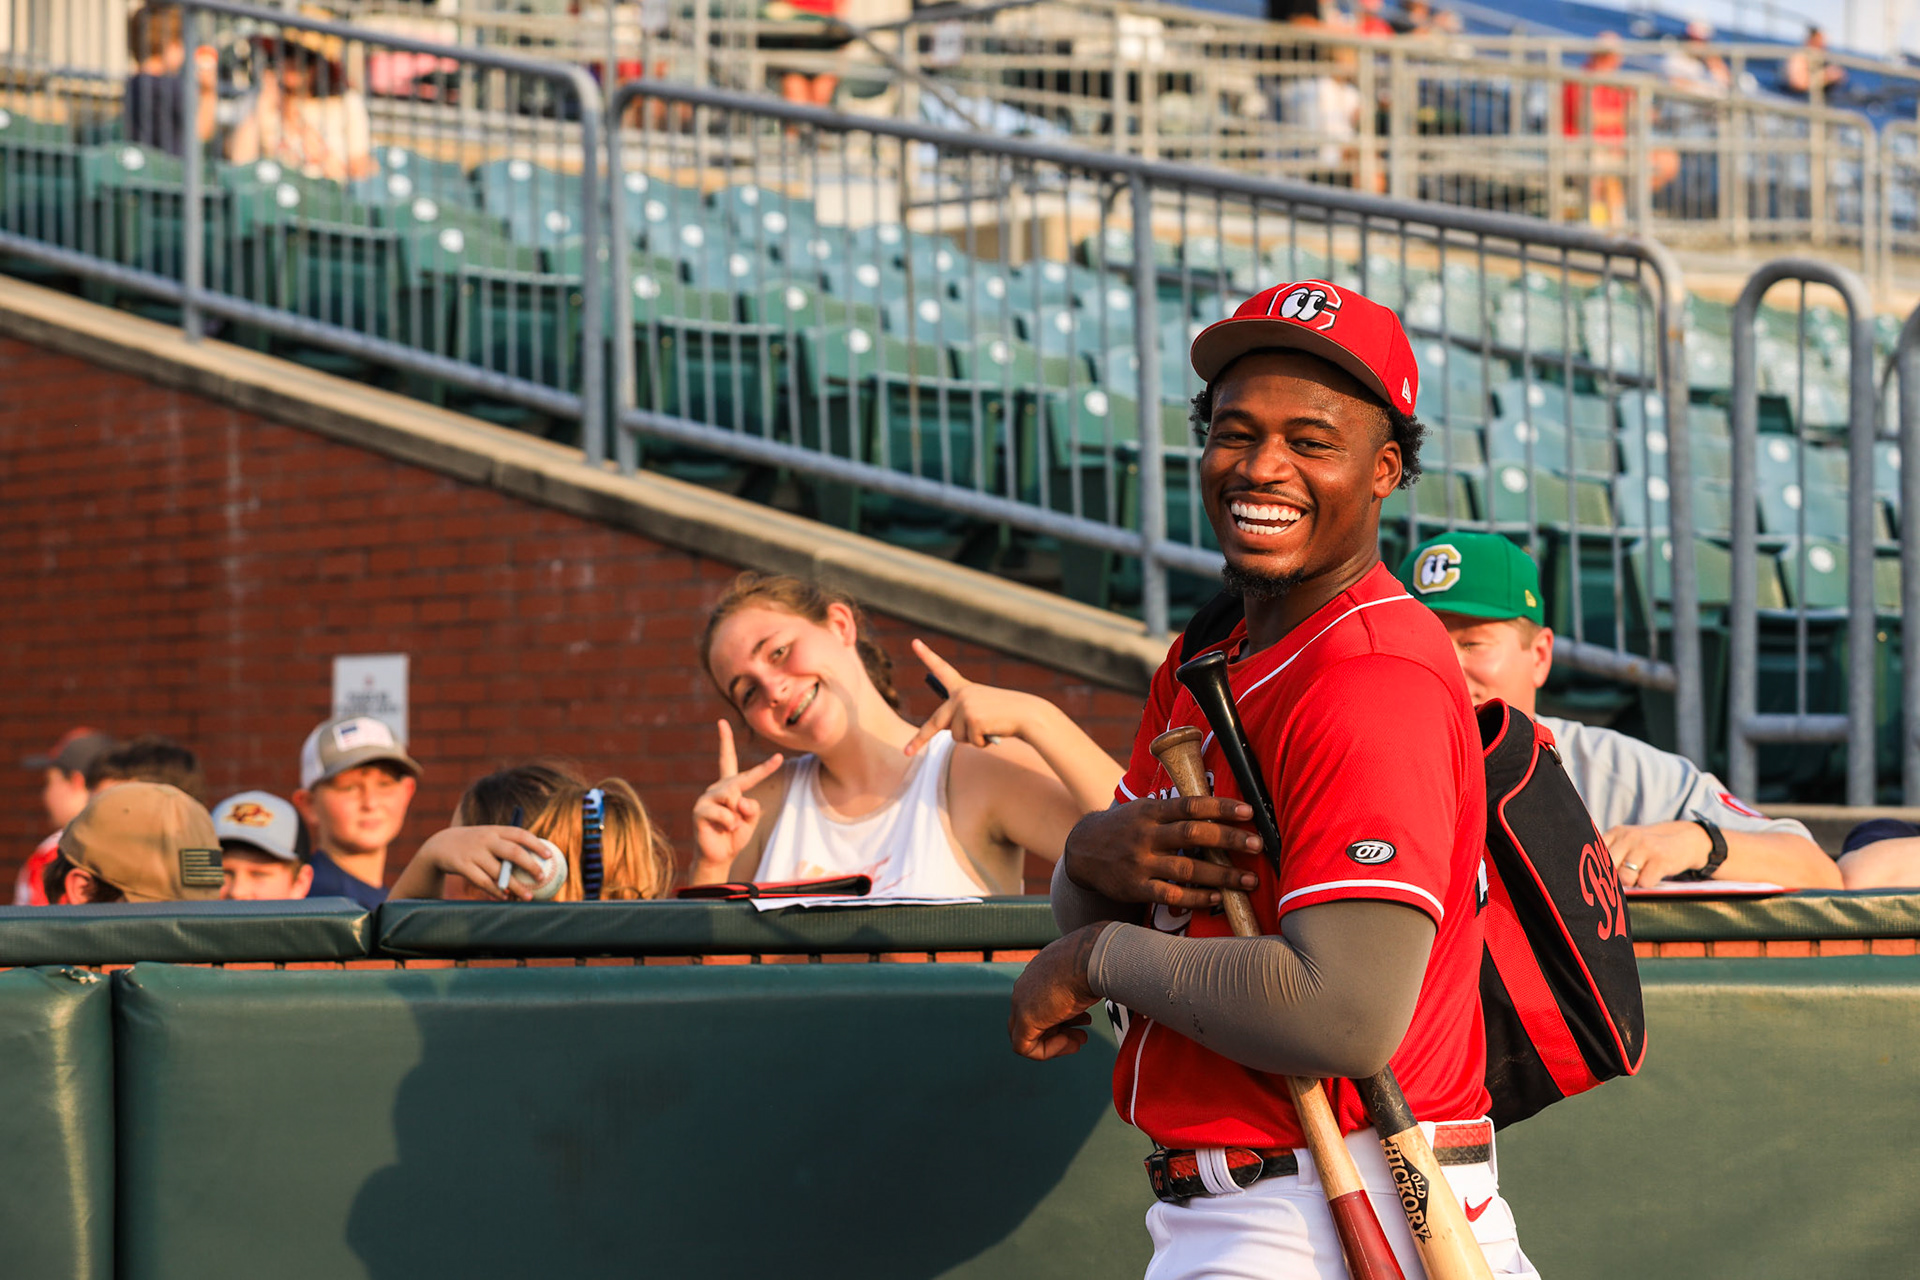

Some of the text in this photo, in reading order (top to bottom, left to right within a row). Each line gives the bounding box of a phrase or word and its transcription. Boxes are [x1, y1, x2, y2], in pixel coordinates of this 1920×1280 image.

[1413, 544, 1462, 595] C
[1384, 1142, 1432, 1239] HICKORY
[1410, 1173, 1426, 1199] OLD
